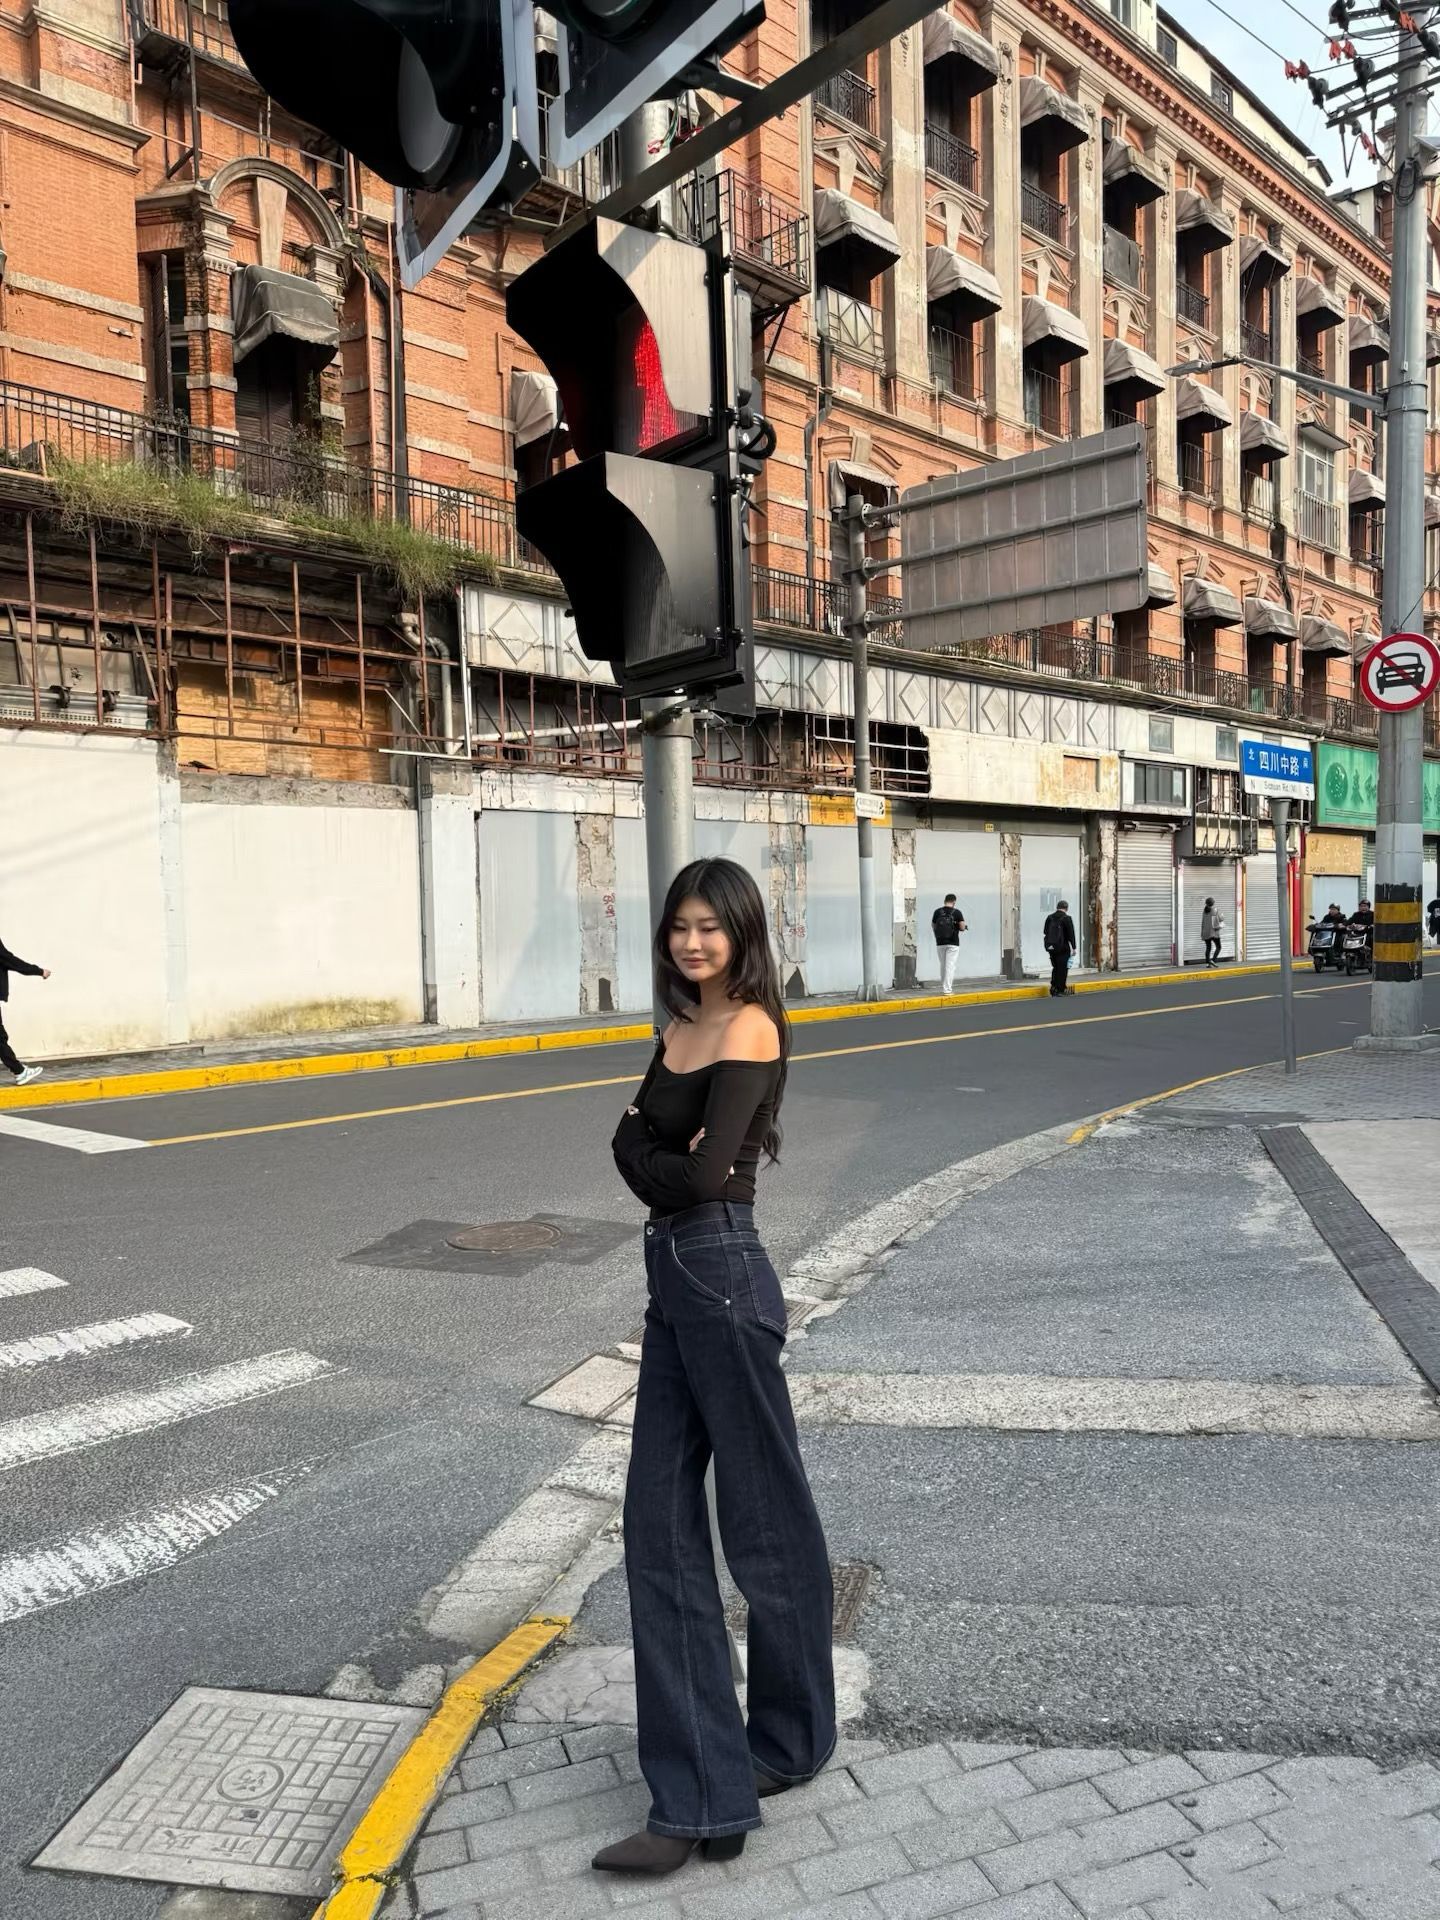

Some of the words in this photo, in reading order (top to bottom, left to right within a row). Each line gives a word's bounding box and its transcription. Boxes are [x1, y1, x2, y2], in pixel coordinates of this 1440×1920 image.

[1248, 748, 1255, 760] 北
[1259, 750, 1300, 776] 四川中路
[1250, 779, 1256, 790] N
[163, 1829, 252, 1857] 市政
